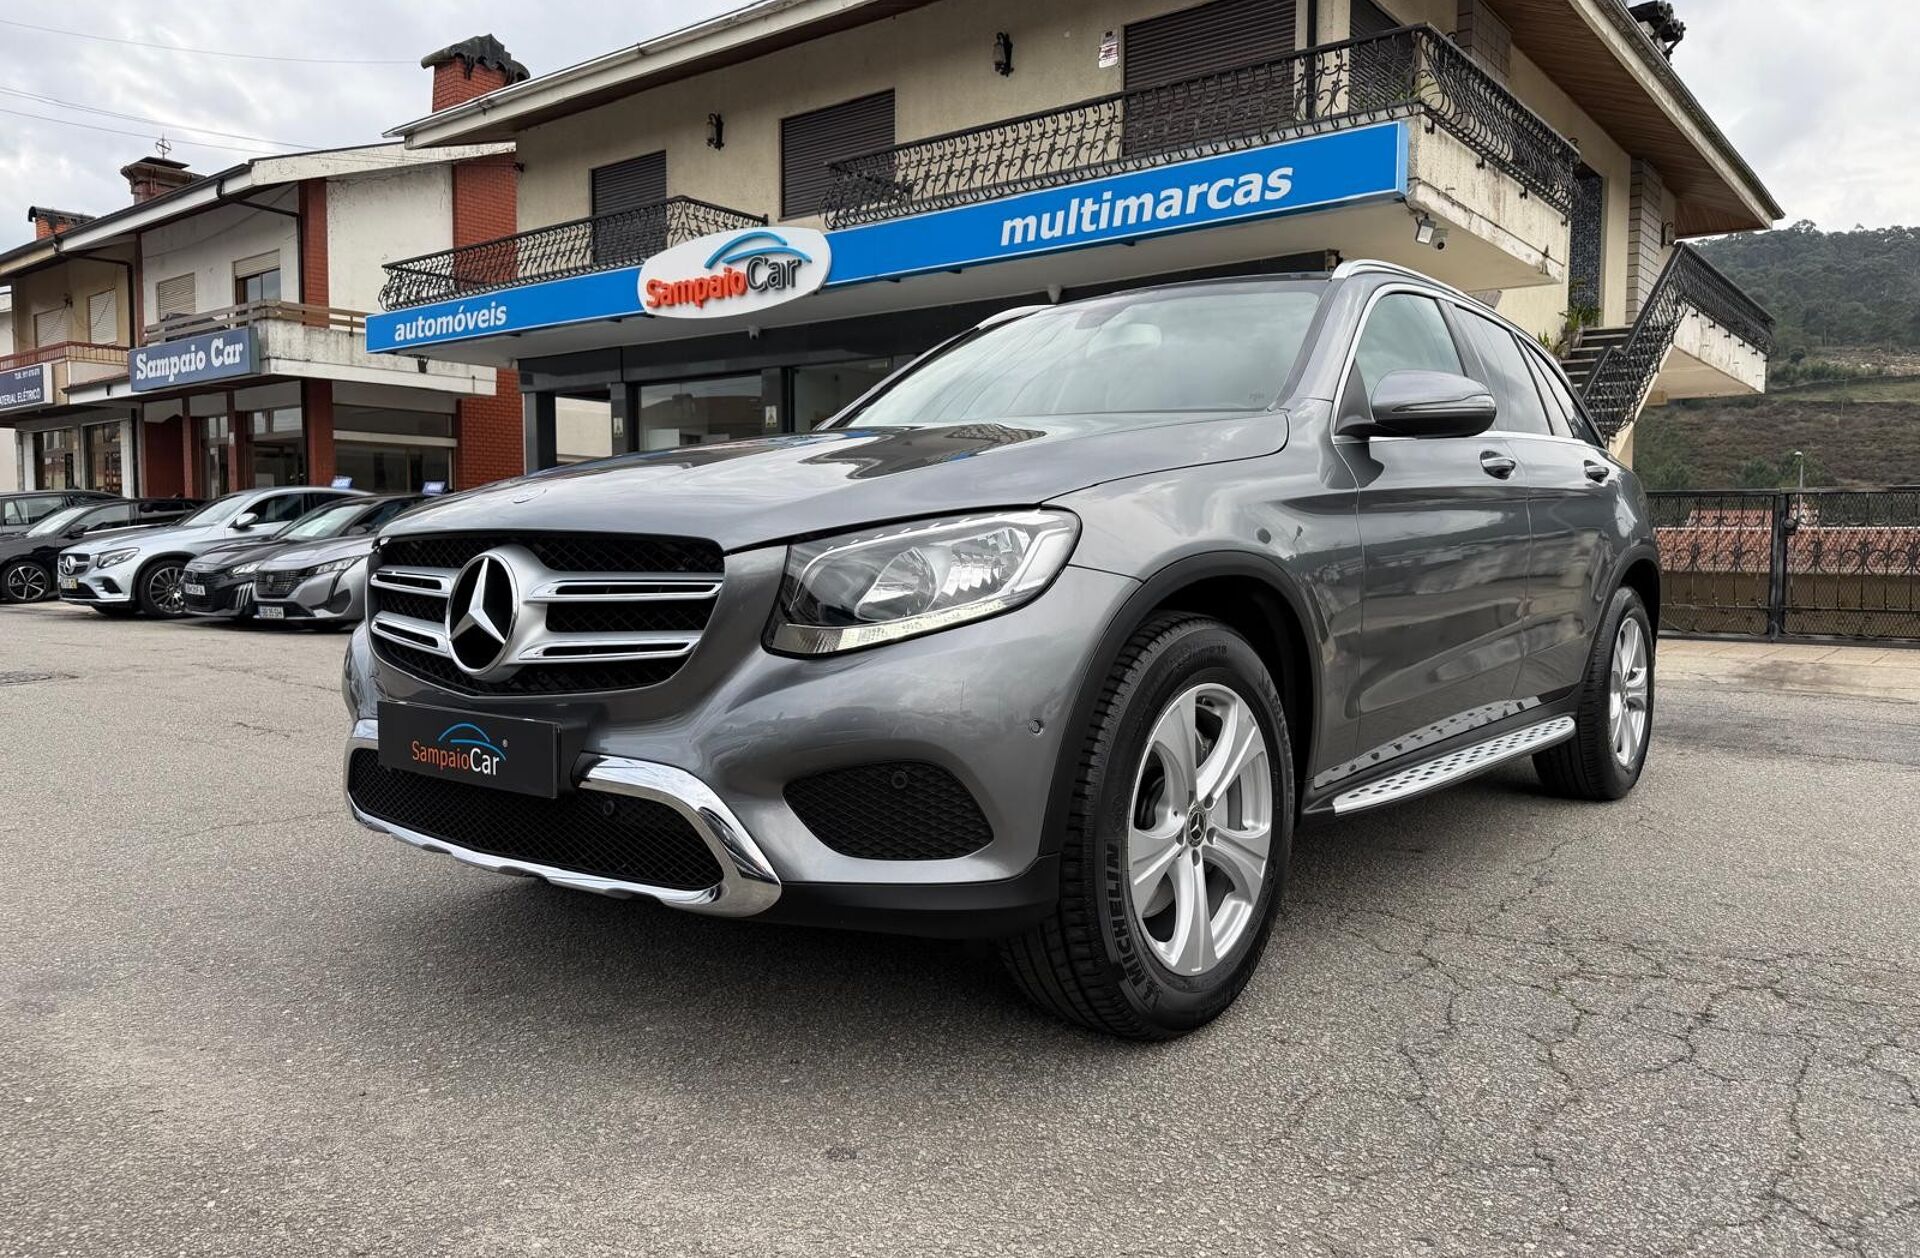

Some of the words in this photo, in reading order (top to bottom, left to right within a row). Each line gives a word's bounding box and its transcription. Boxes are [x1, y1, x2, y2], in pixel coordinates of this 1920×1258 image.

[1001, 166, 1293, 246] multimarcas
[646, 256, 802, 309] SampaioCar
[395, 301, 507, 341] automóveis
[136, 345, 206, 382] Sampaio
[211, 338, 243, 367] Car
[412, 740, 500, 776] SampaioCar
[1105, 844, 1145, 986] MICHELIN
